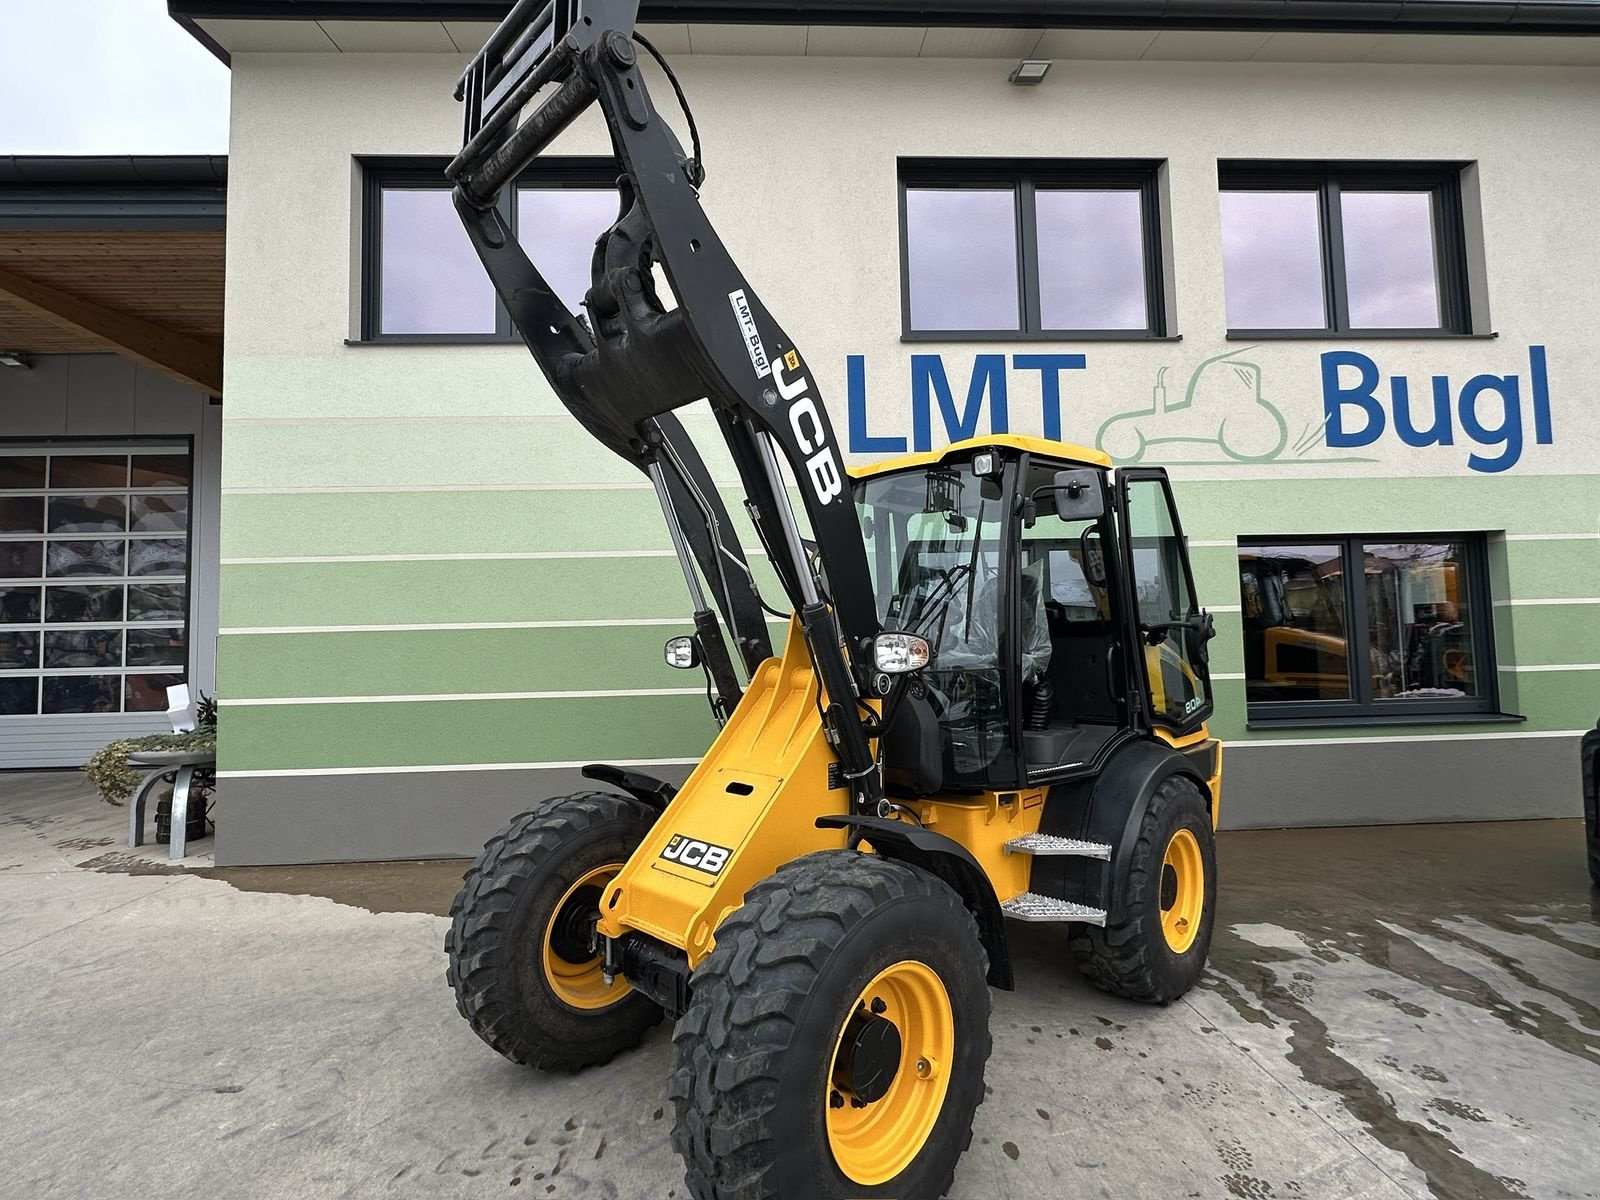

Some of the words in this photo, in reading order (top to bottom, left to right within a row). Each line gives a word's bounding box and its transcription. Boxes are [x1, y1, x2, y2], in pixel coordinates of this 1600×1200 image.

[771, 357, 842, 506] JCB
[847, 354, 1086, 453] LMT
[1320, 345, 1553, 473] Bugl
[663, 838, 729, 873] JCB
